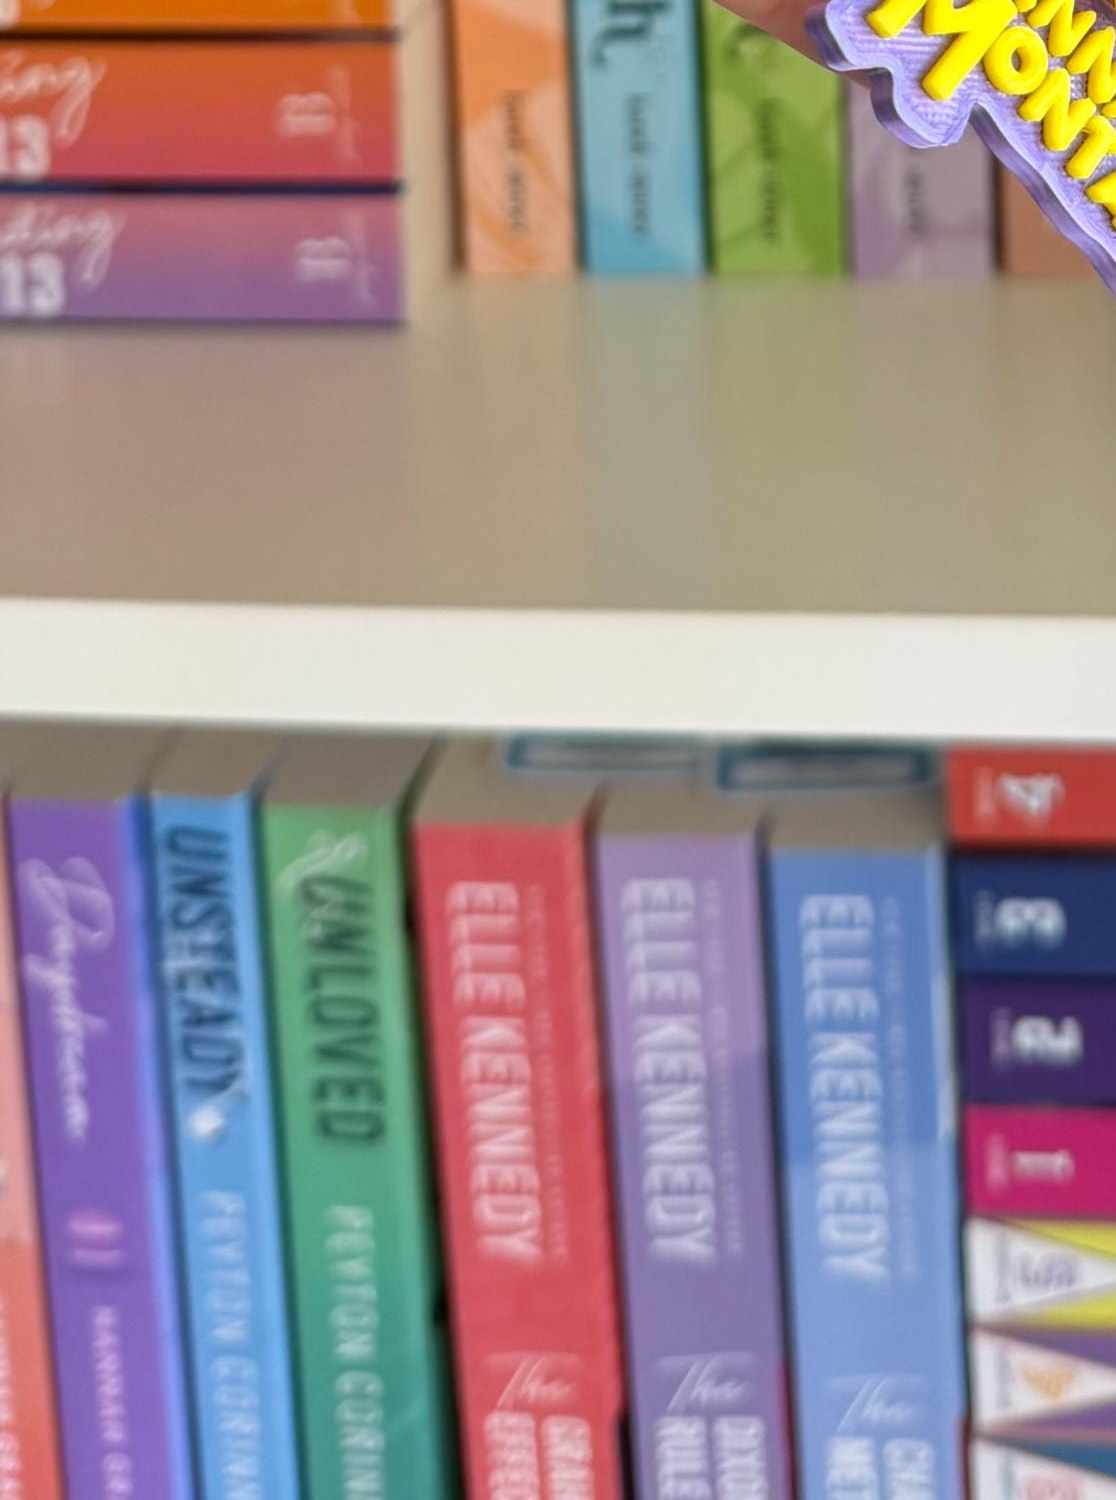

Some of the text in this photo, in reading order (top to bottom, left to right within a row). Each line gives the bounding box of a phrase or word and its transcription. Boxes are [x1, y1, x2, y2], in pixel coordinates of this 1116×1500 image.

[164, 826, 247, 1098] UNSTEADY
[303, 874, 387, 1147] UNLOVED
[447, 881, 543, 1265] ELLE KENNEDY
[621, 879, 717, 1264] ELLE KENNEDY
[801, 895, 891, 1281] ELLE KENNEDY
[200, 1190, 250, 1345] PEYTON
[325, 1205, 386, 1500] PEYTON CORIN
